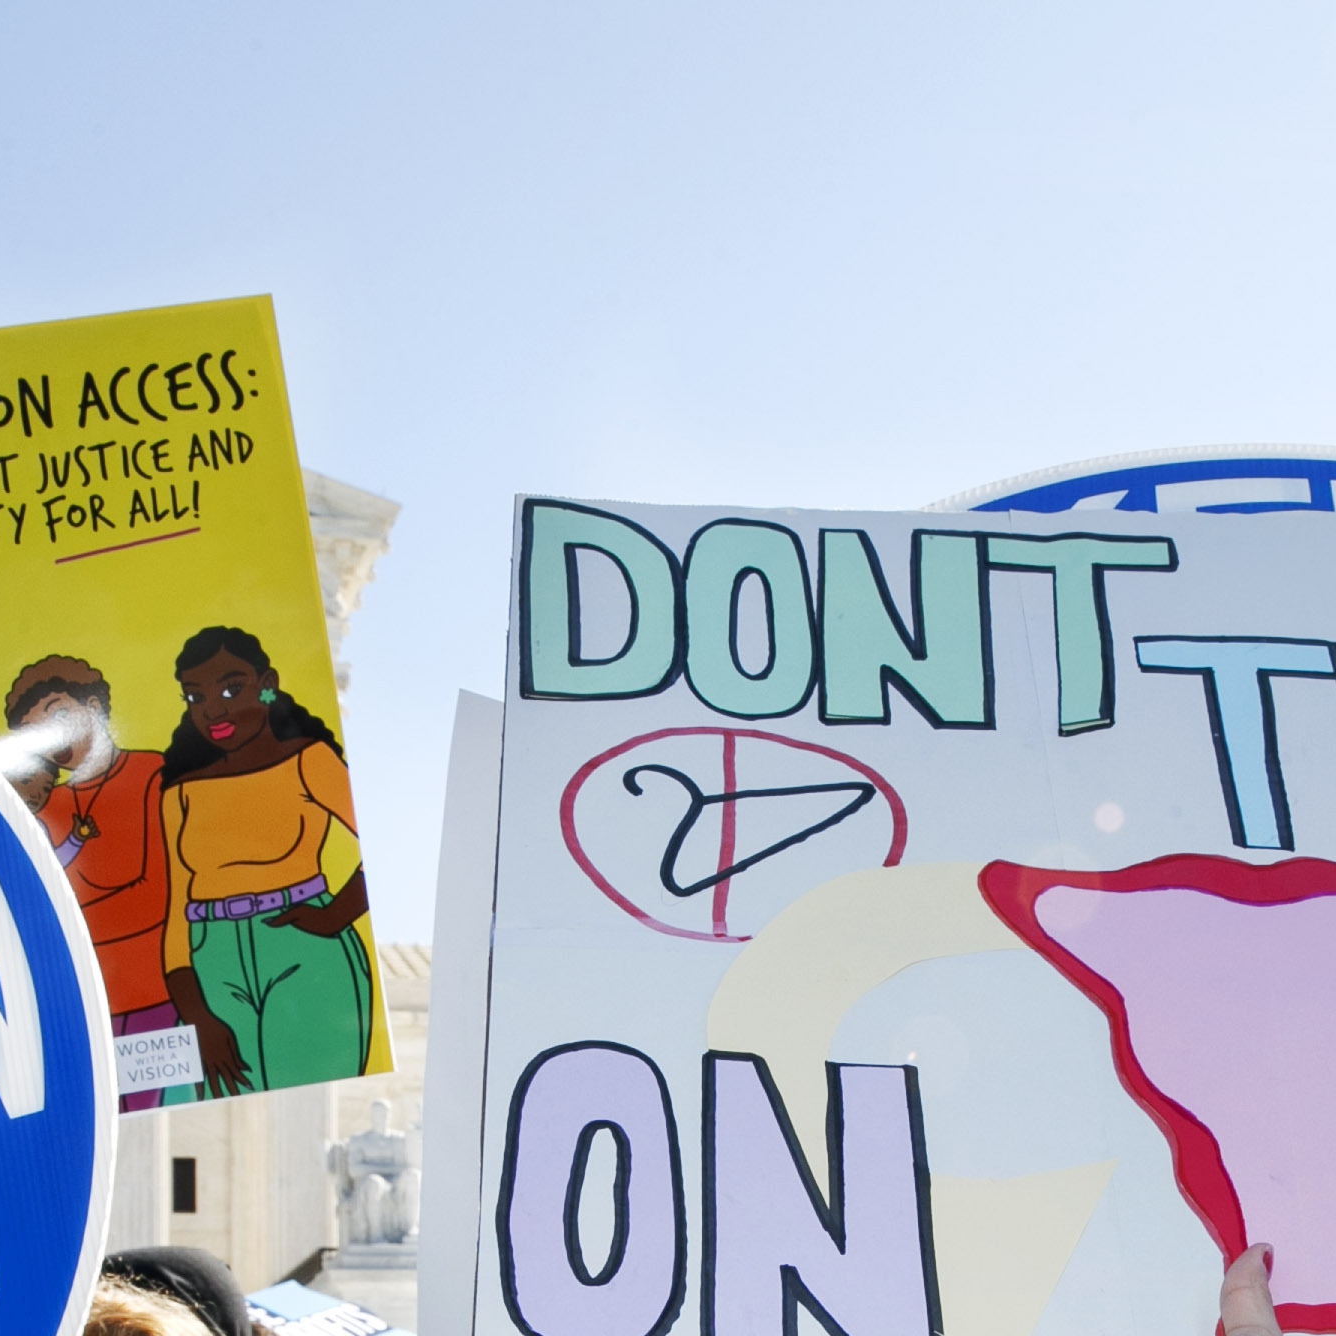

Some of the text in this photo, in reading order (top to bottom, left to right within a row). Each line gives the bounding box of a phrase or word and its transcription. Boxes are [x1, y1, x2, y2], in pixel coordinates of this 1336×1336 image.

[78, 349, 259, 428] ACCESS:
[35, 438, 174, 494] JUSTICE
[187, 427, 254, 473] AND
[44, 494, 116, 543] FOR
[128, 480, 201, 529] ALL!
[519, 496, 1179, 736] DONT
[116, 1033, 192, 1056] WOMEN
[126, 1062, 190, 1083] VISION
[136, 1052, 177, 1066] WITH A
